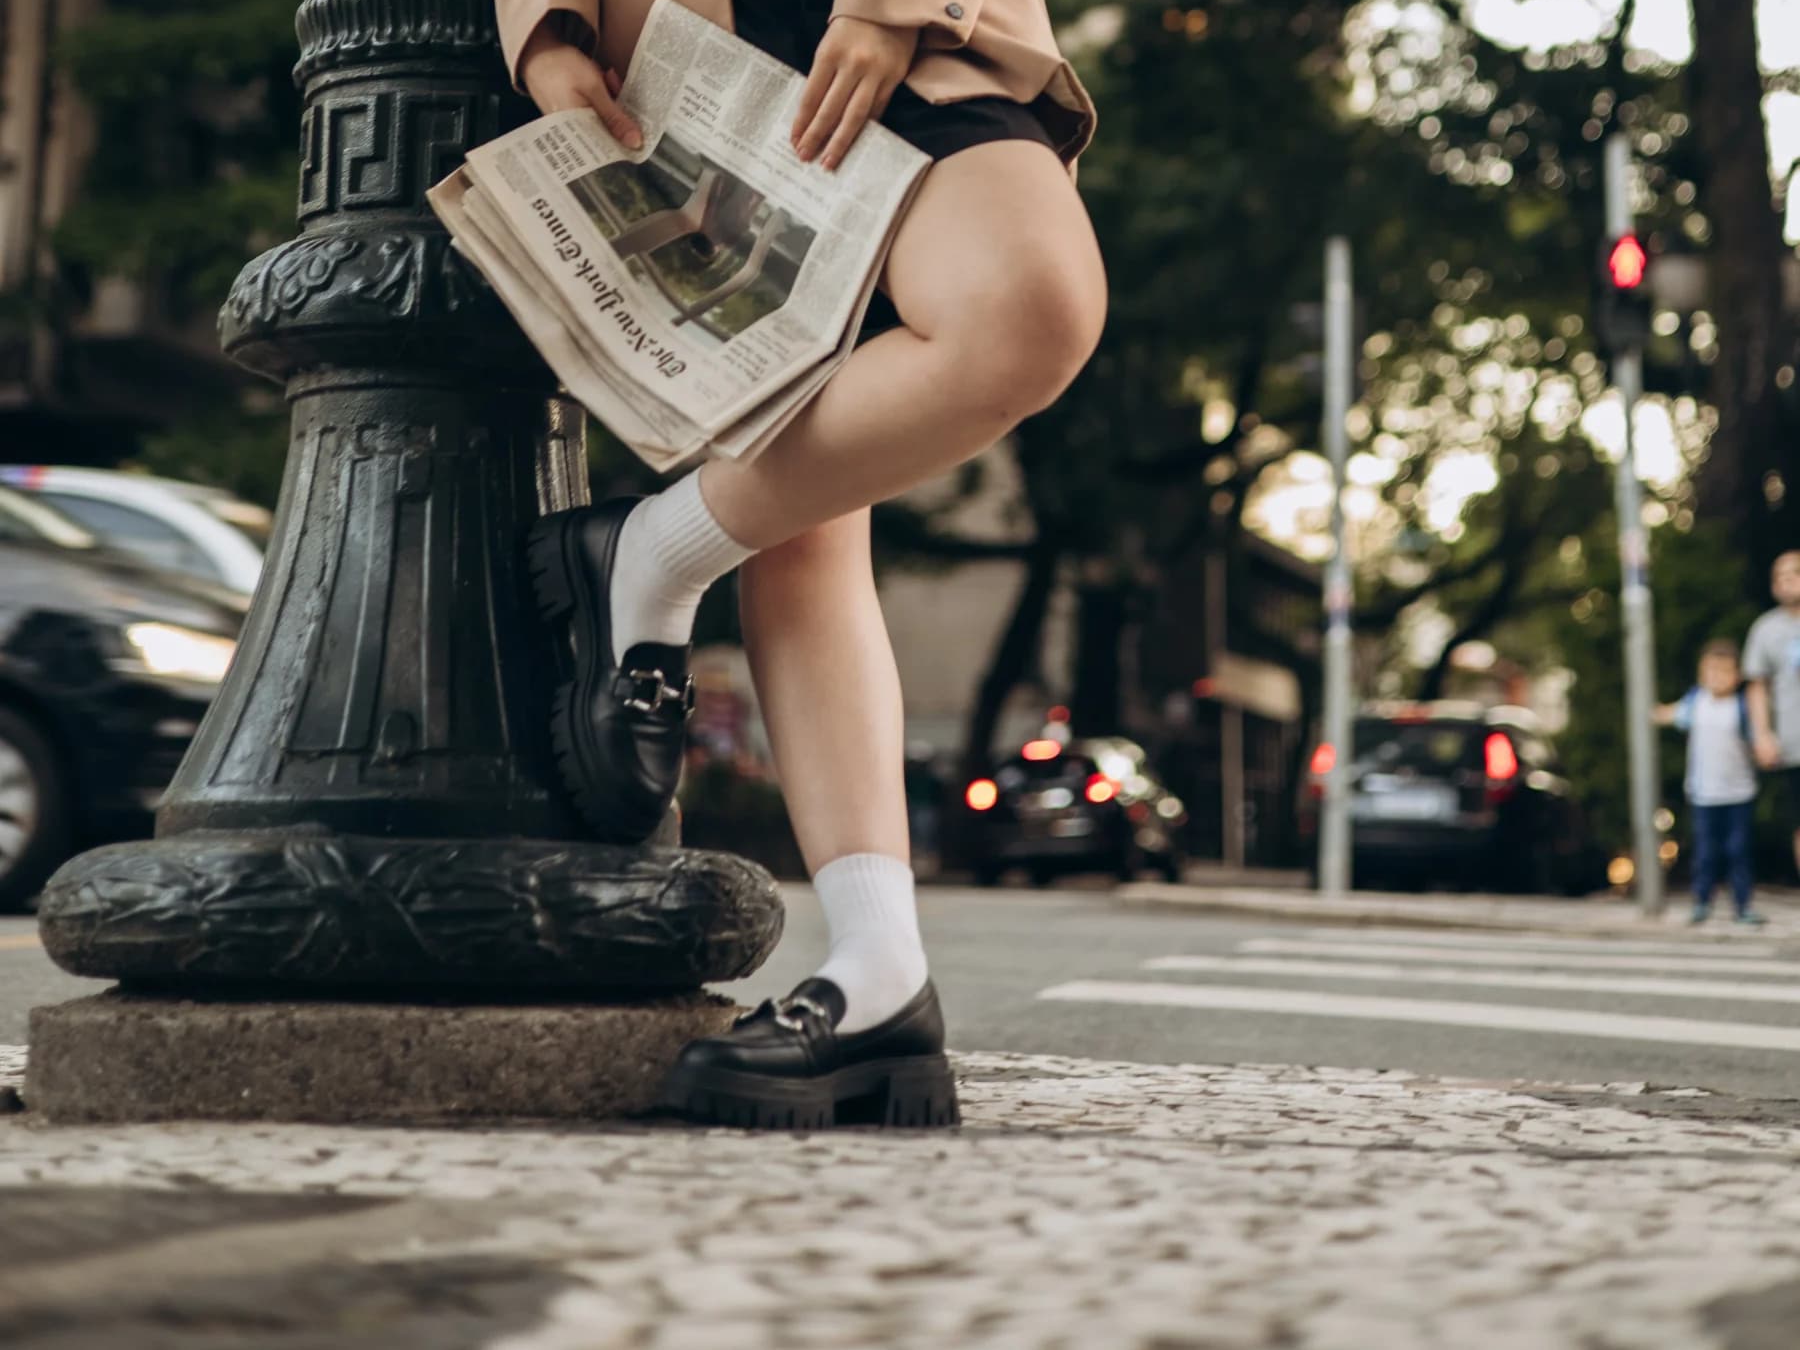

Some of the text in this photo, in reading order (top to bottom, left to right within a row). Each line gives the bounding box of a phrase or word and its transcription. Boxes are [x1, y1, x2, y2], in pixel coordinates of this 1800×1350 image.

[531, 198, 687, 379] The New York Times
